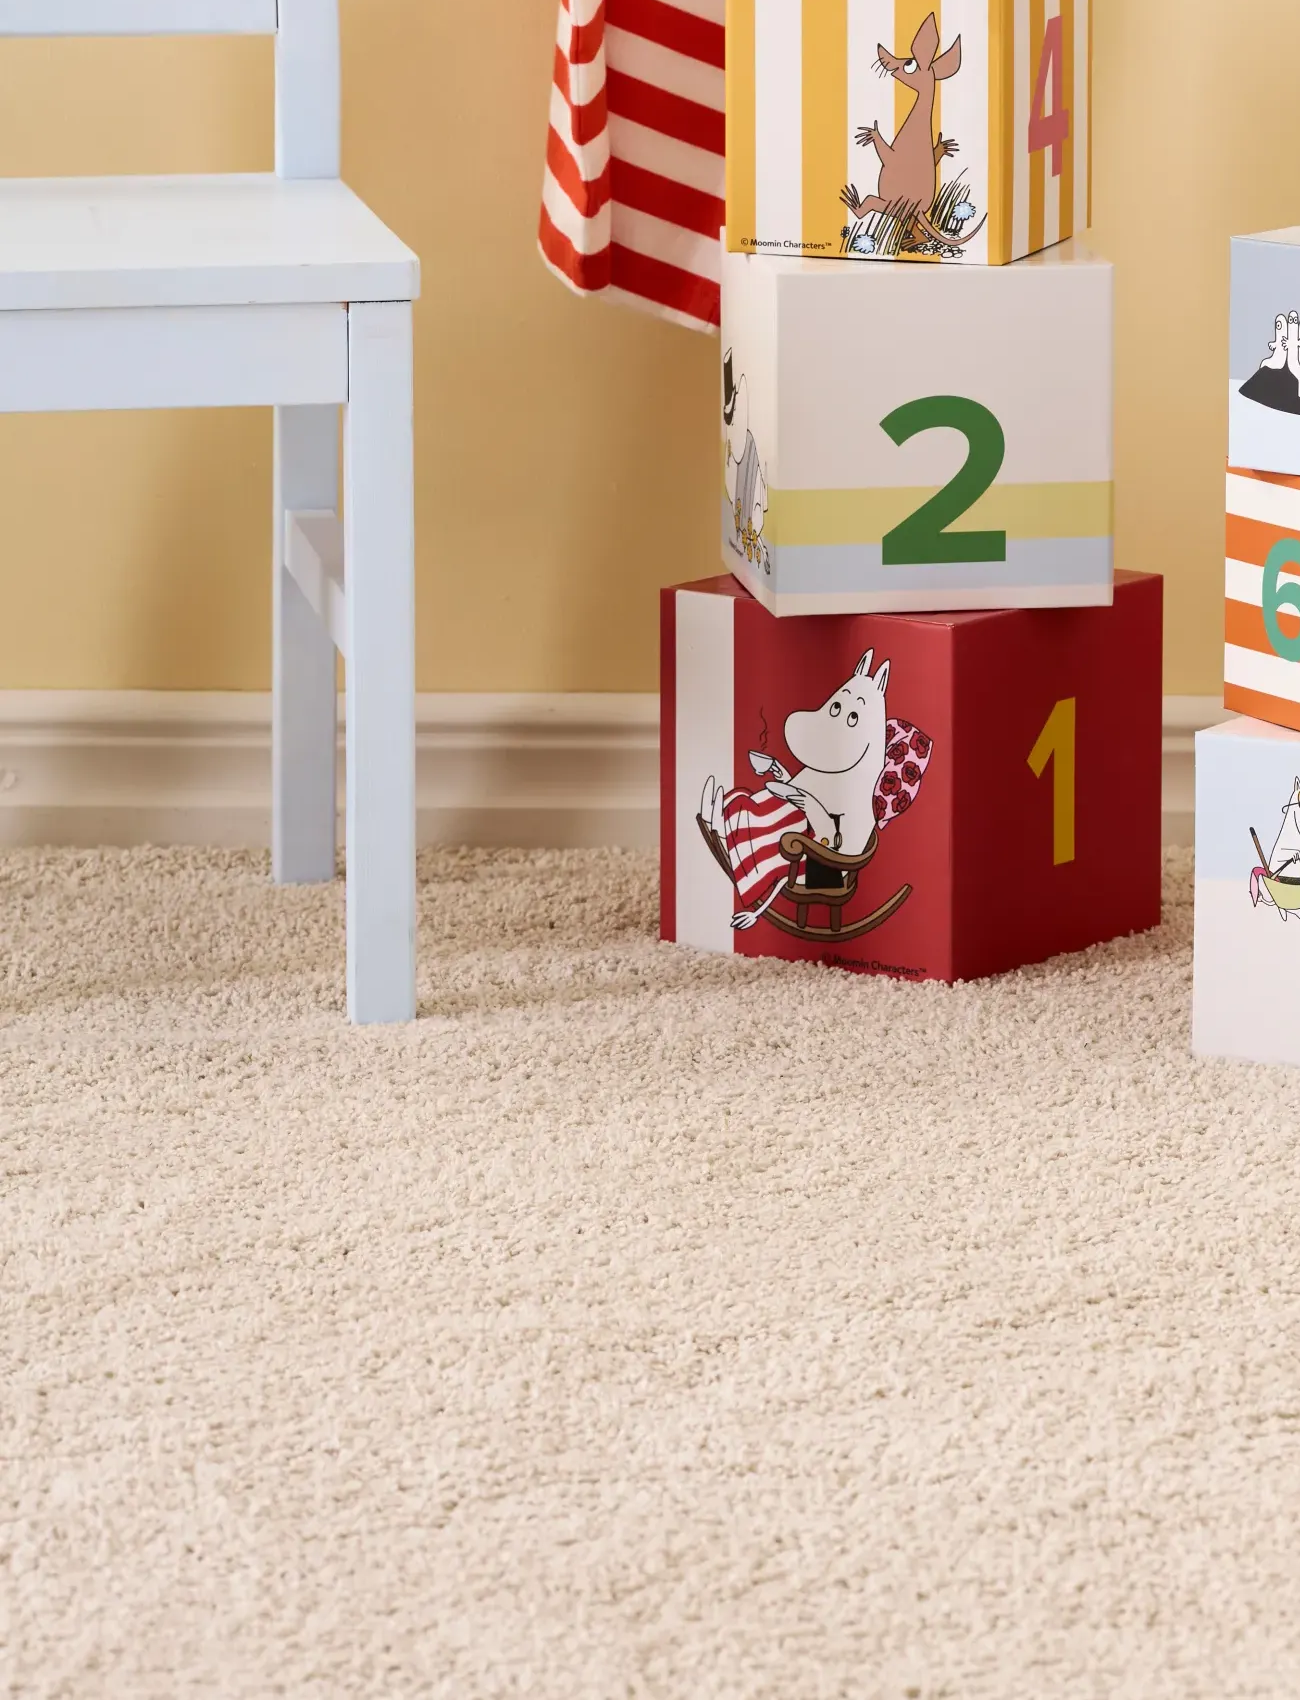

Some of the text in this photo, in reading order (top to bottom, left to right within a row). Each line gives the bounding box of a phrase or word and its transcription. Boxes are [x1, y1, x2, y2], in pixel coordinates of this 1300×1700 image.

[1027, 15, 1070, 178] 4
[750, 238, 782, 248] Moomin
[783, 240, 832, 250] Characters™
[879, 395, 1007, 566] 2
[1026, 696, 1076, 866] 1
[833, 955, 869, 969] Moomin
